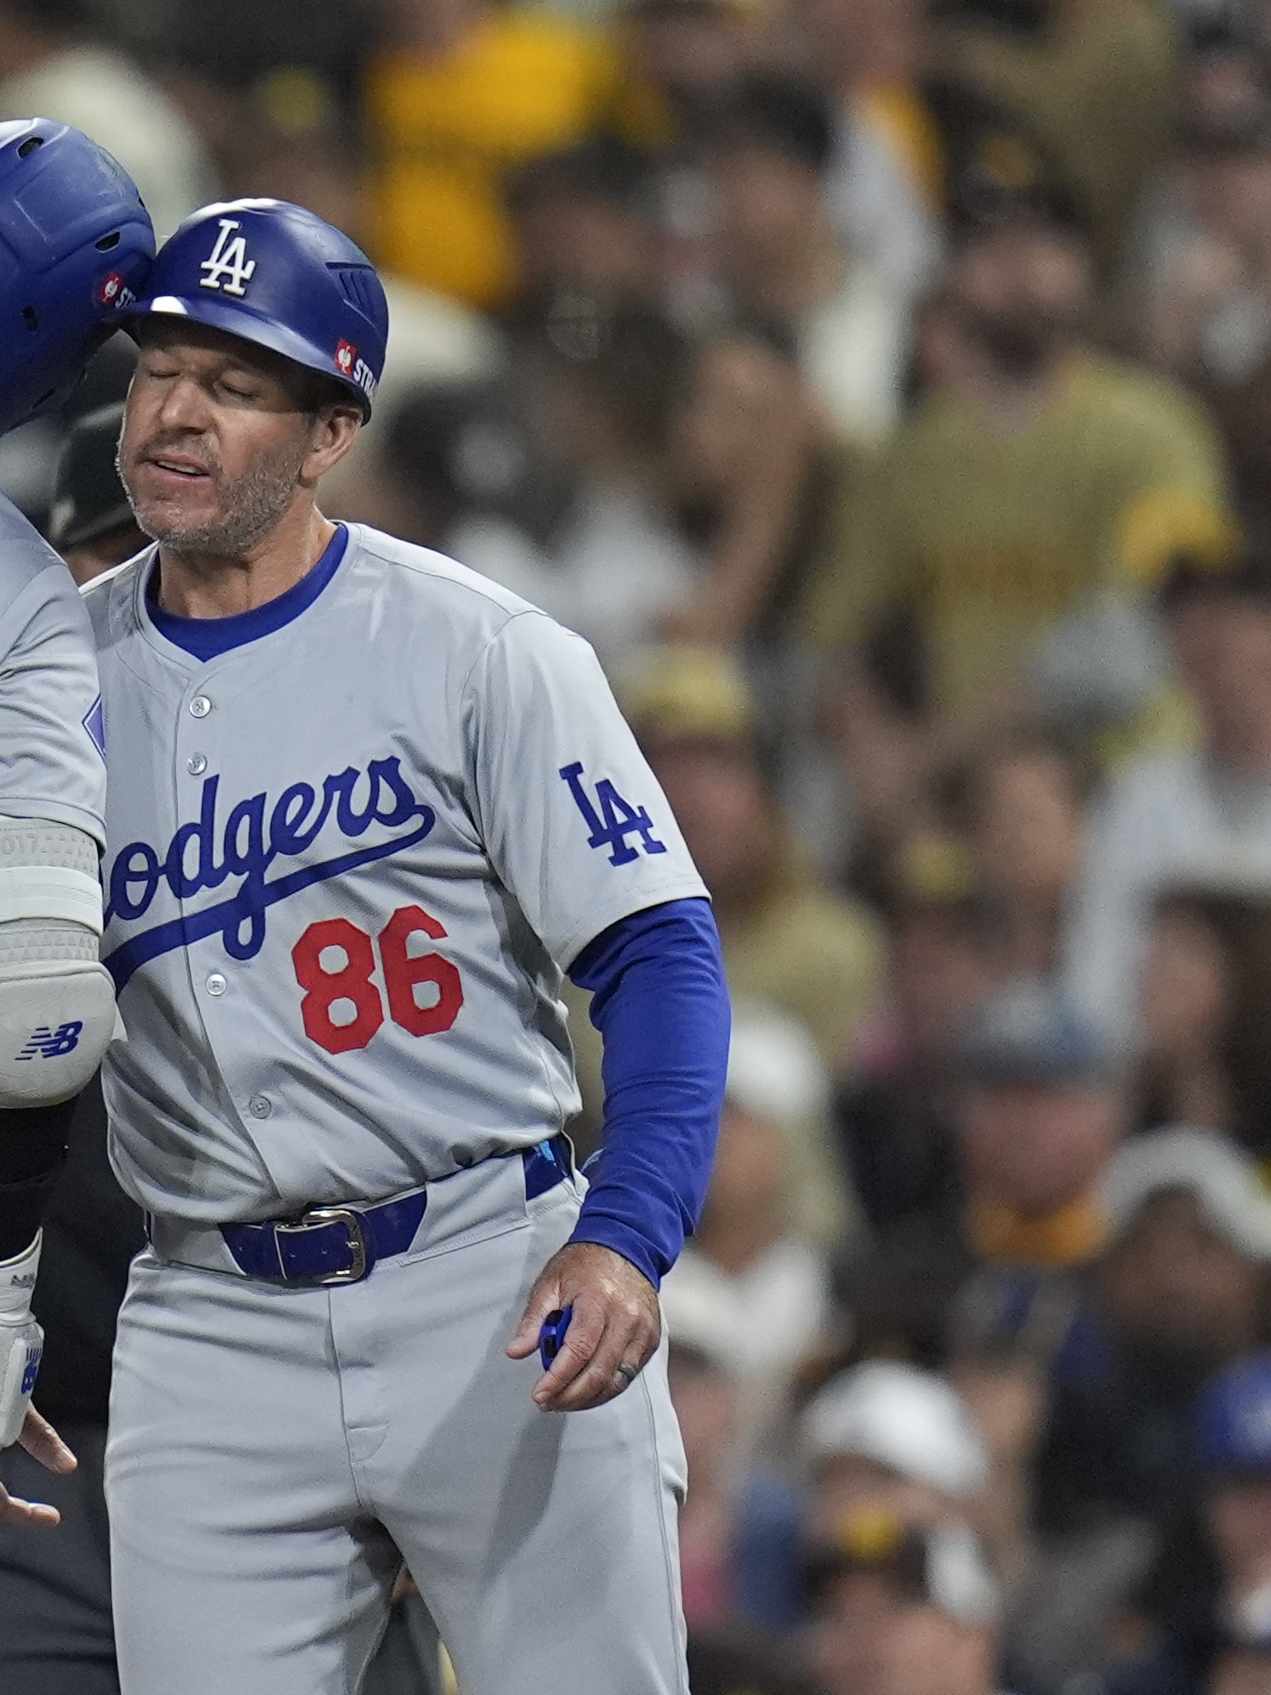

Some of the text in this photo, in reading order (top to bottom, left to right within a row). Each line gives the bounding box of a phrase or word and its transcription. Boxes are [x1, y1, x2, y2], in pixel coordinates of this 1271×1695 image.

[200, 218, 256, 296] LA
[103, 755, 433, 961] odgers
[559, 761, 667, 867] LA
[291, 904, 464, 1055] 86
